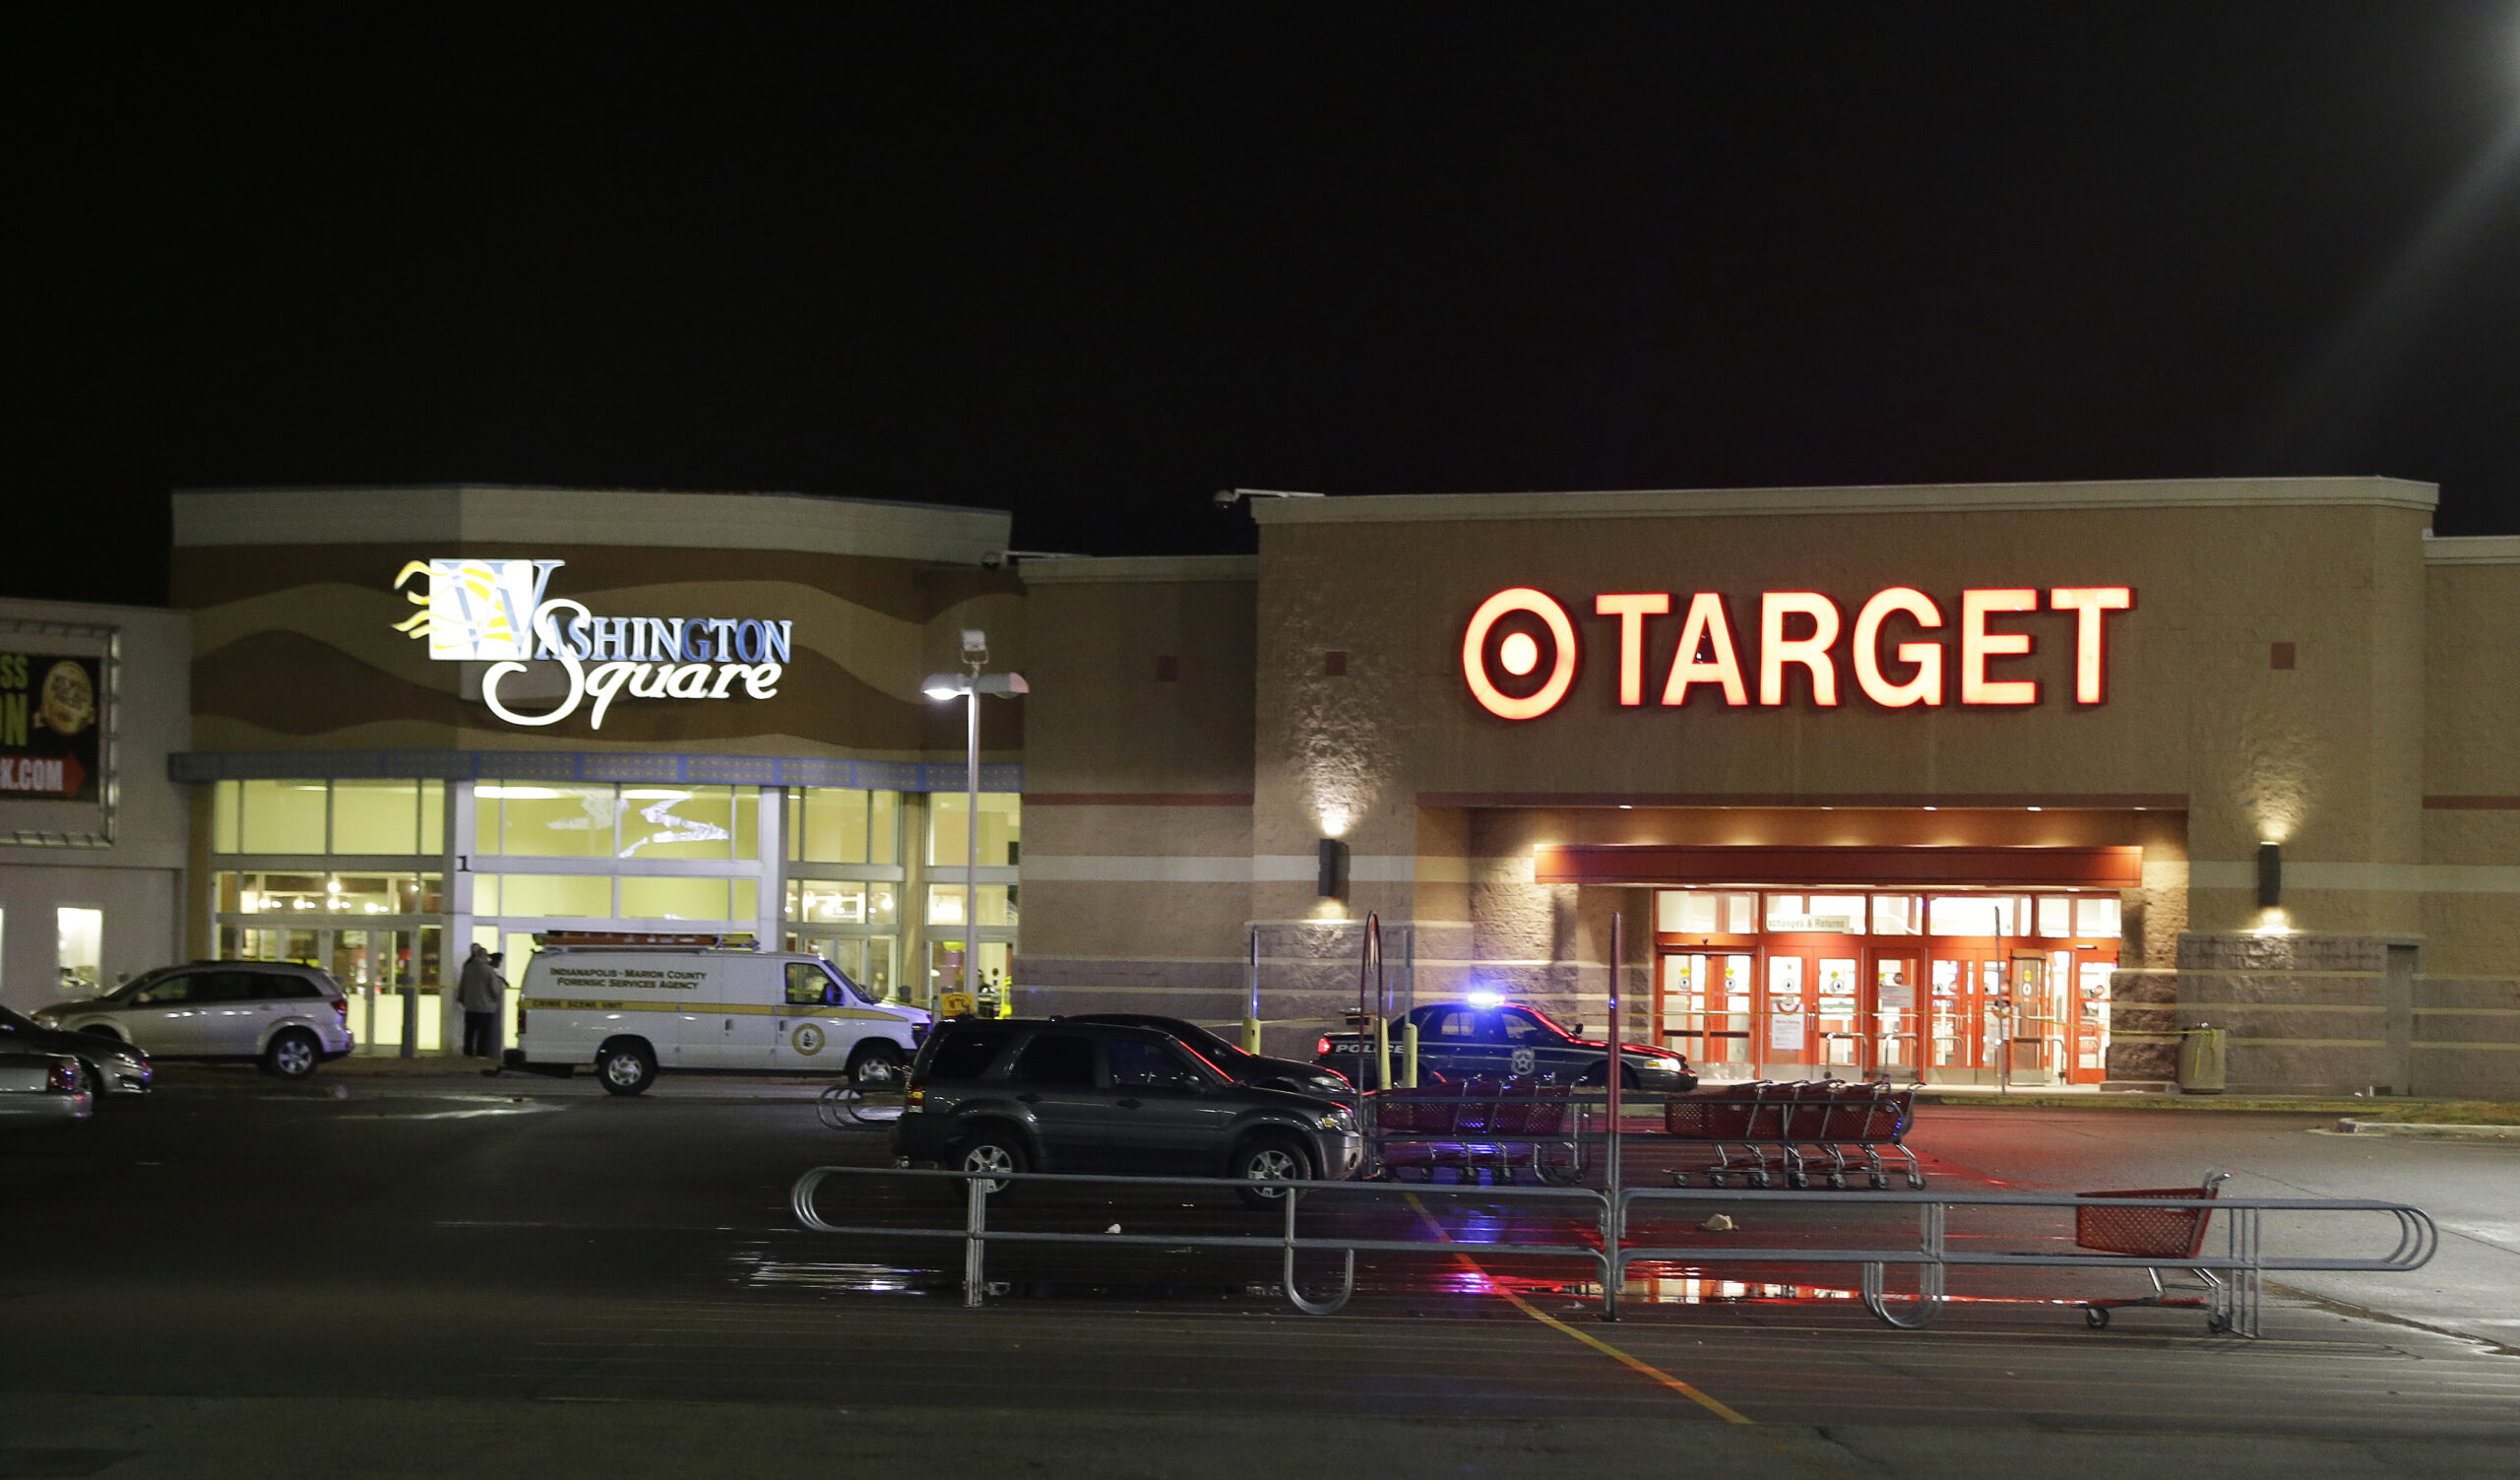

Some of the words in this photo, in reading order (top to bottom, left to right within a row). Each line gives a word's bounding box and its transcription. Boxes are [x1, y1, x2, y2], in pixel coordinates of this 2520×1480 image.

[431, 558, 793, 663] WASHINGTON
[482, 598, 784, 731] Square
[1596, 587, 2130, 707] TARGET
[457, 854, 472, 872] 1
[557, 977, 605, 987] FORENSIC
[608, 979, 657, 989] SERVICES
[660, 981, 699, 990] AGENCY
[624, 969, 664, 979] MARION
[666, 970, 707, 980] COUNTY
